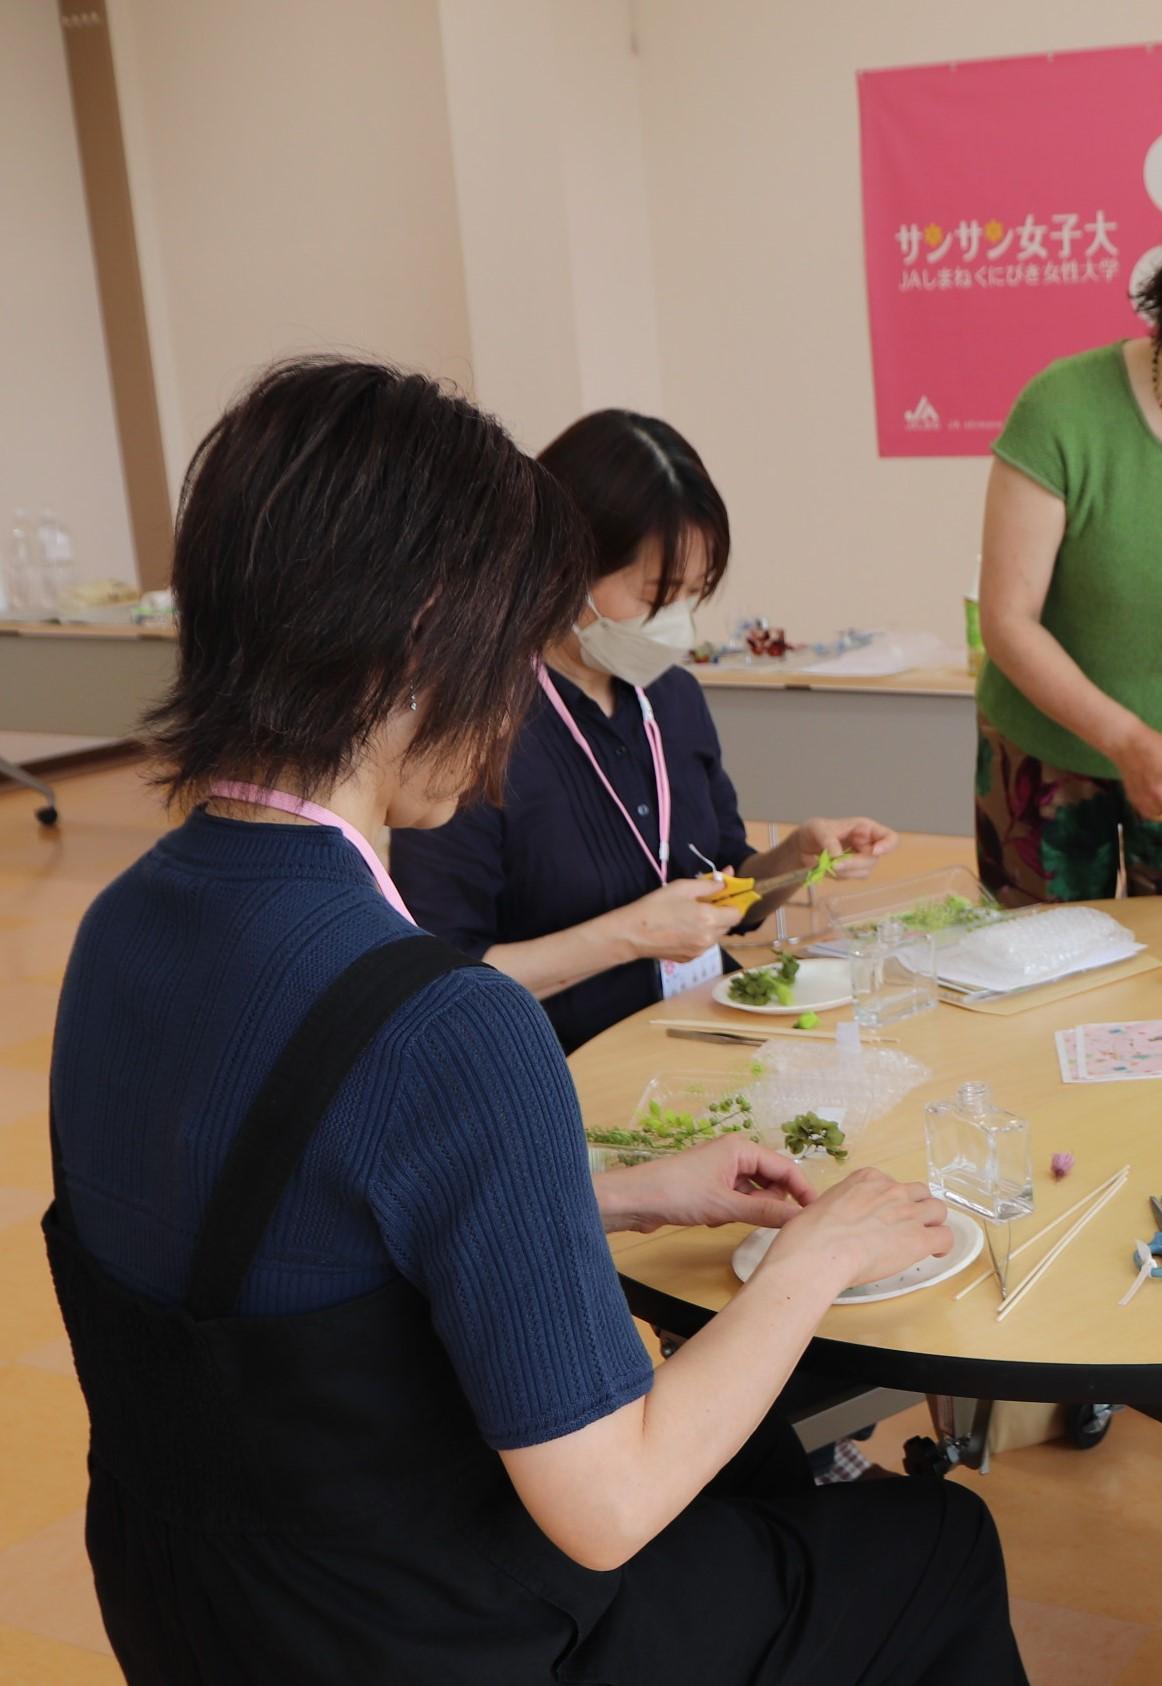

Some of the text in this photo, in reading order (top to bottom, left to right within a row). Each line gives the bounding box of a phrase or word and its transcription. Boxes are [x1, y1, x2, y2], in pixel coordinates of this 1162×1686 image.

[895, 209, 1120, 266] サンサン女子大
